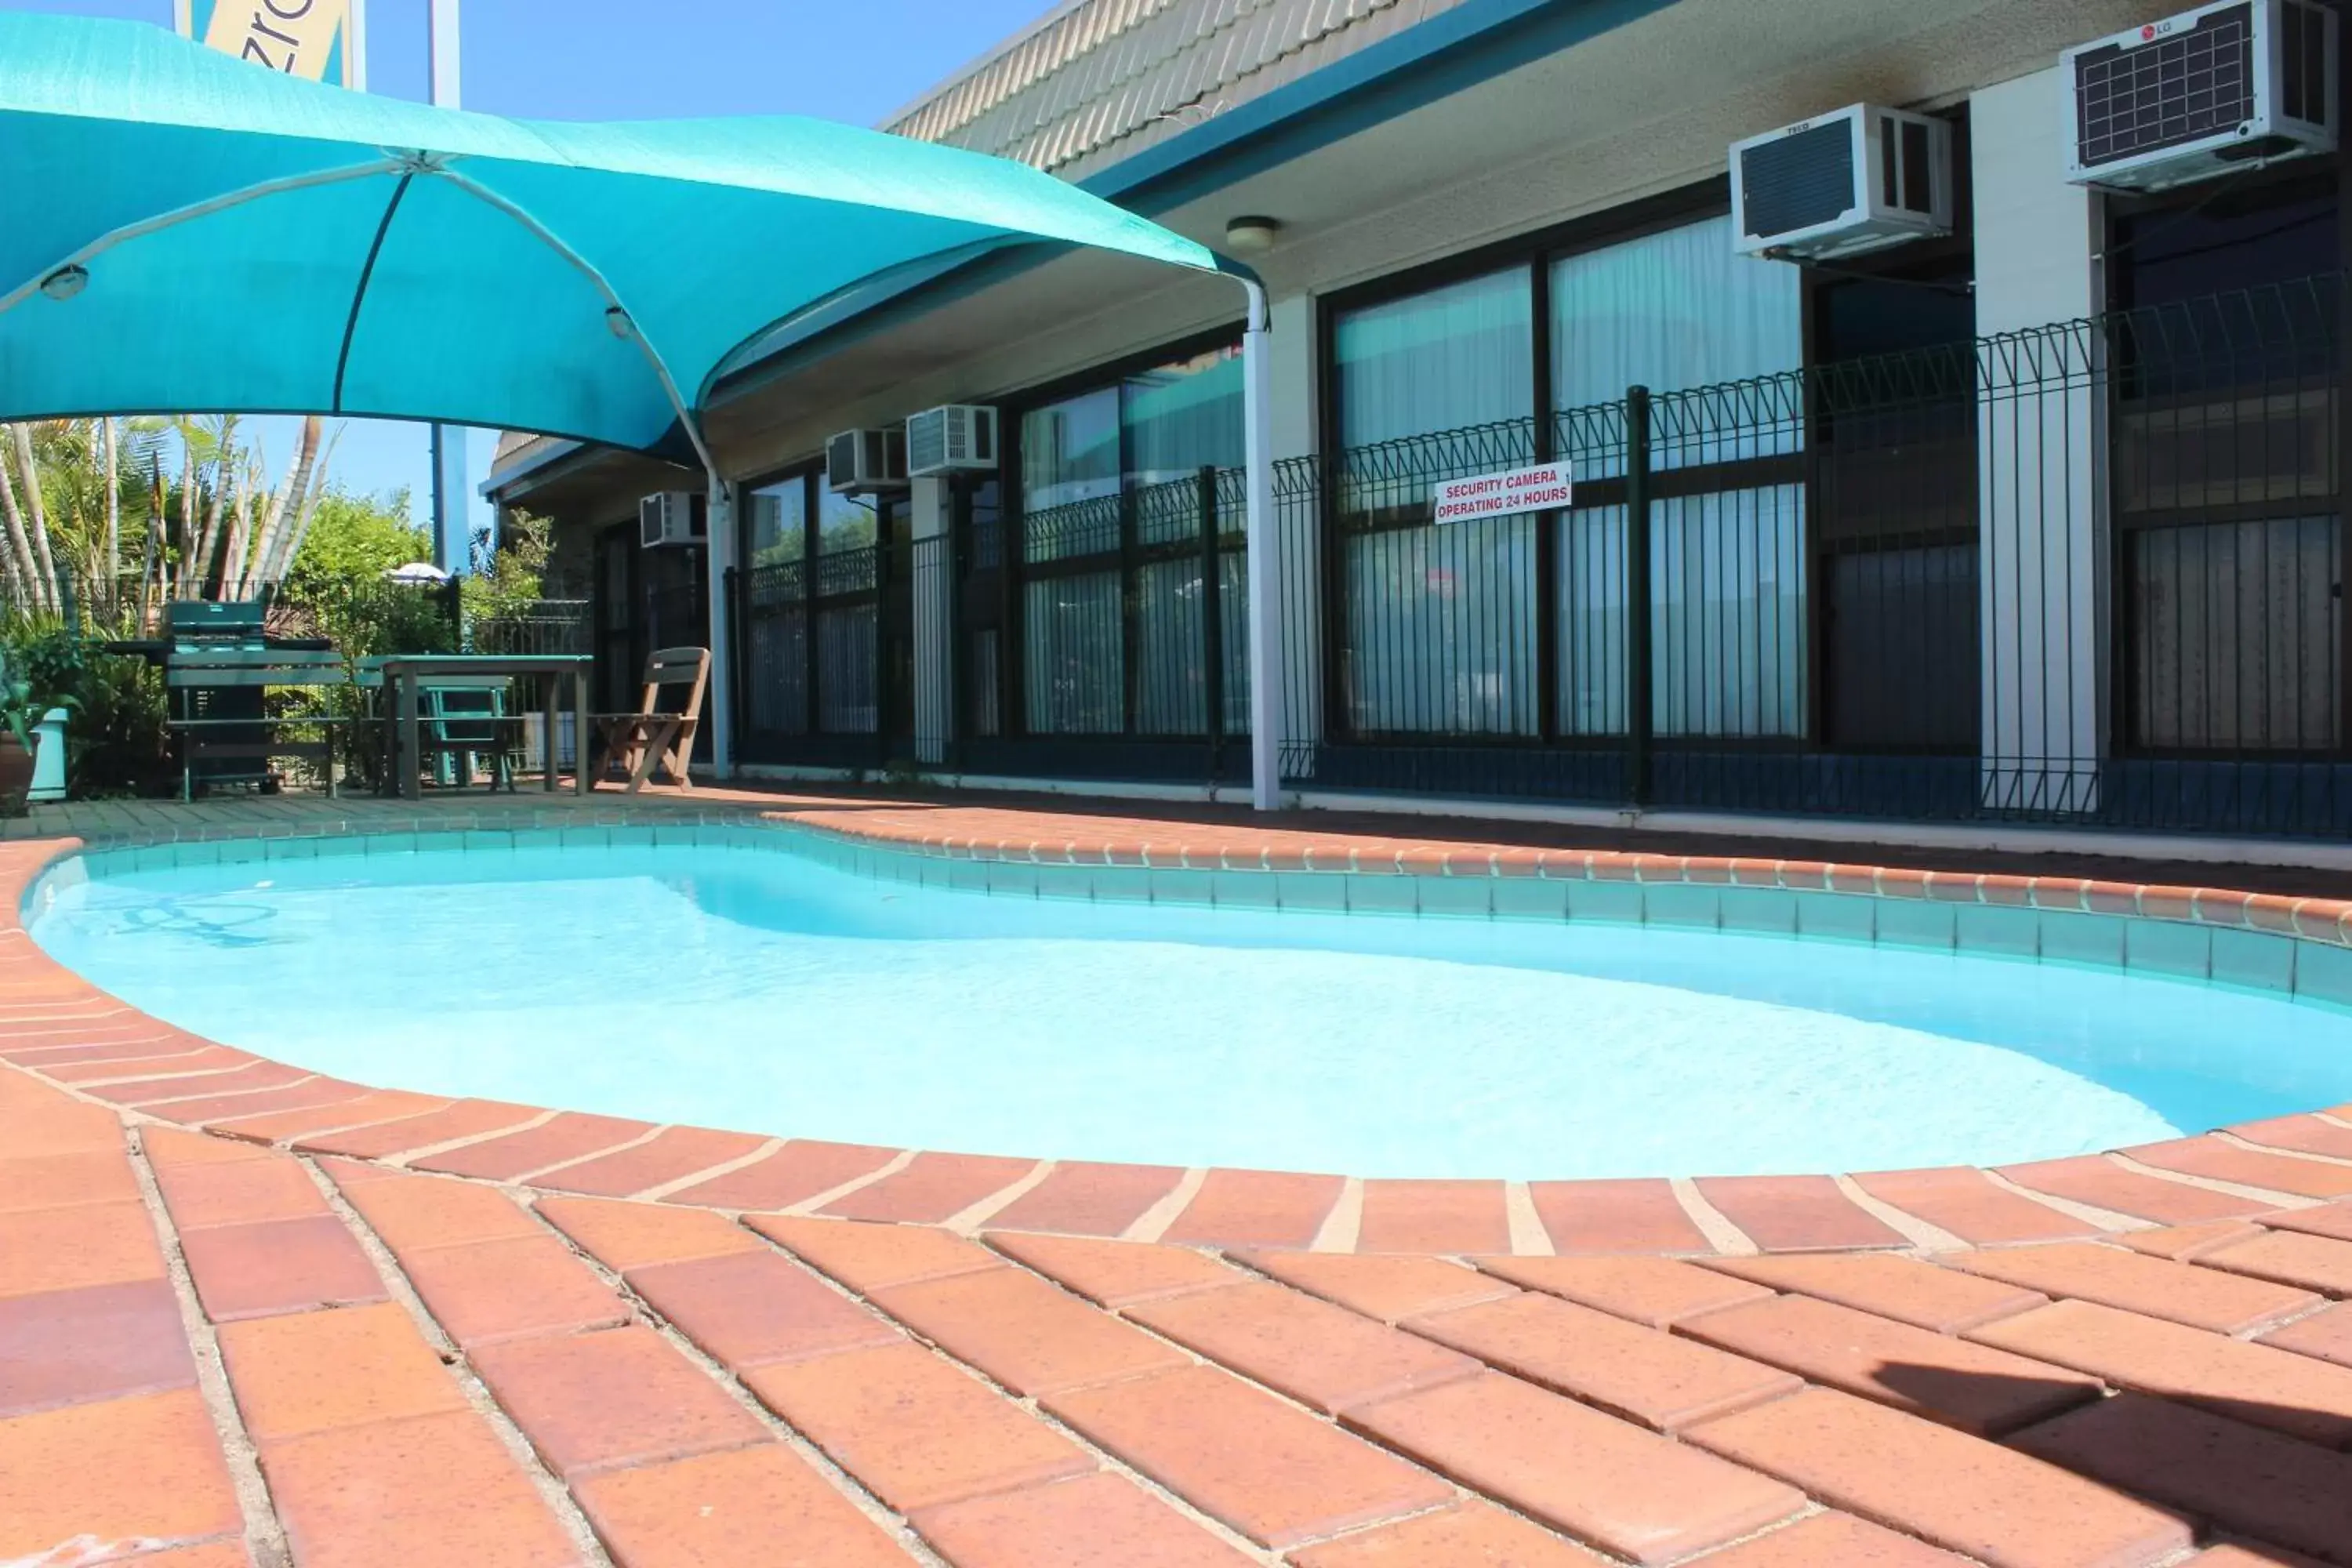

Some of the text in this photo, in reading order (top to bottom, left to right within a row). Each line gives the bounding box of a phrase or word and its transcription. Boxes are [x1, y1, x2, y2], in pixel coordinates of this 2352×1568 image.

[2157, 22, 2171, 34] LG
[1446, 470, 1557, 498] SECURITY CAMERA
[1438, 487, 1567, 517] OPERATING 24 HOURS
